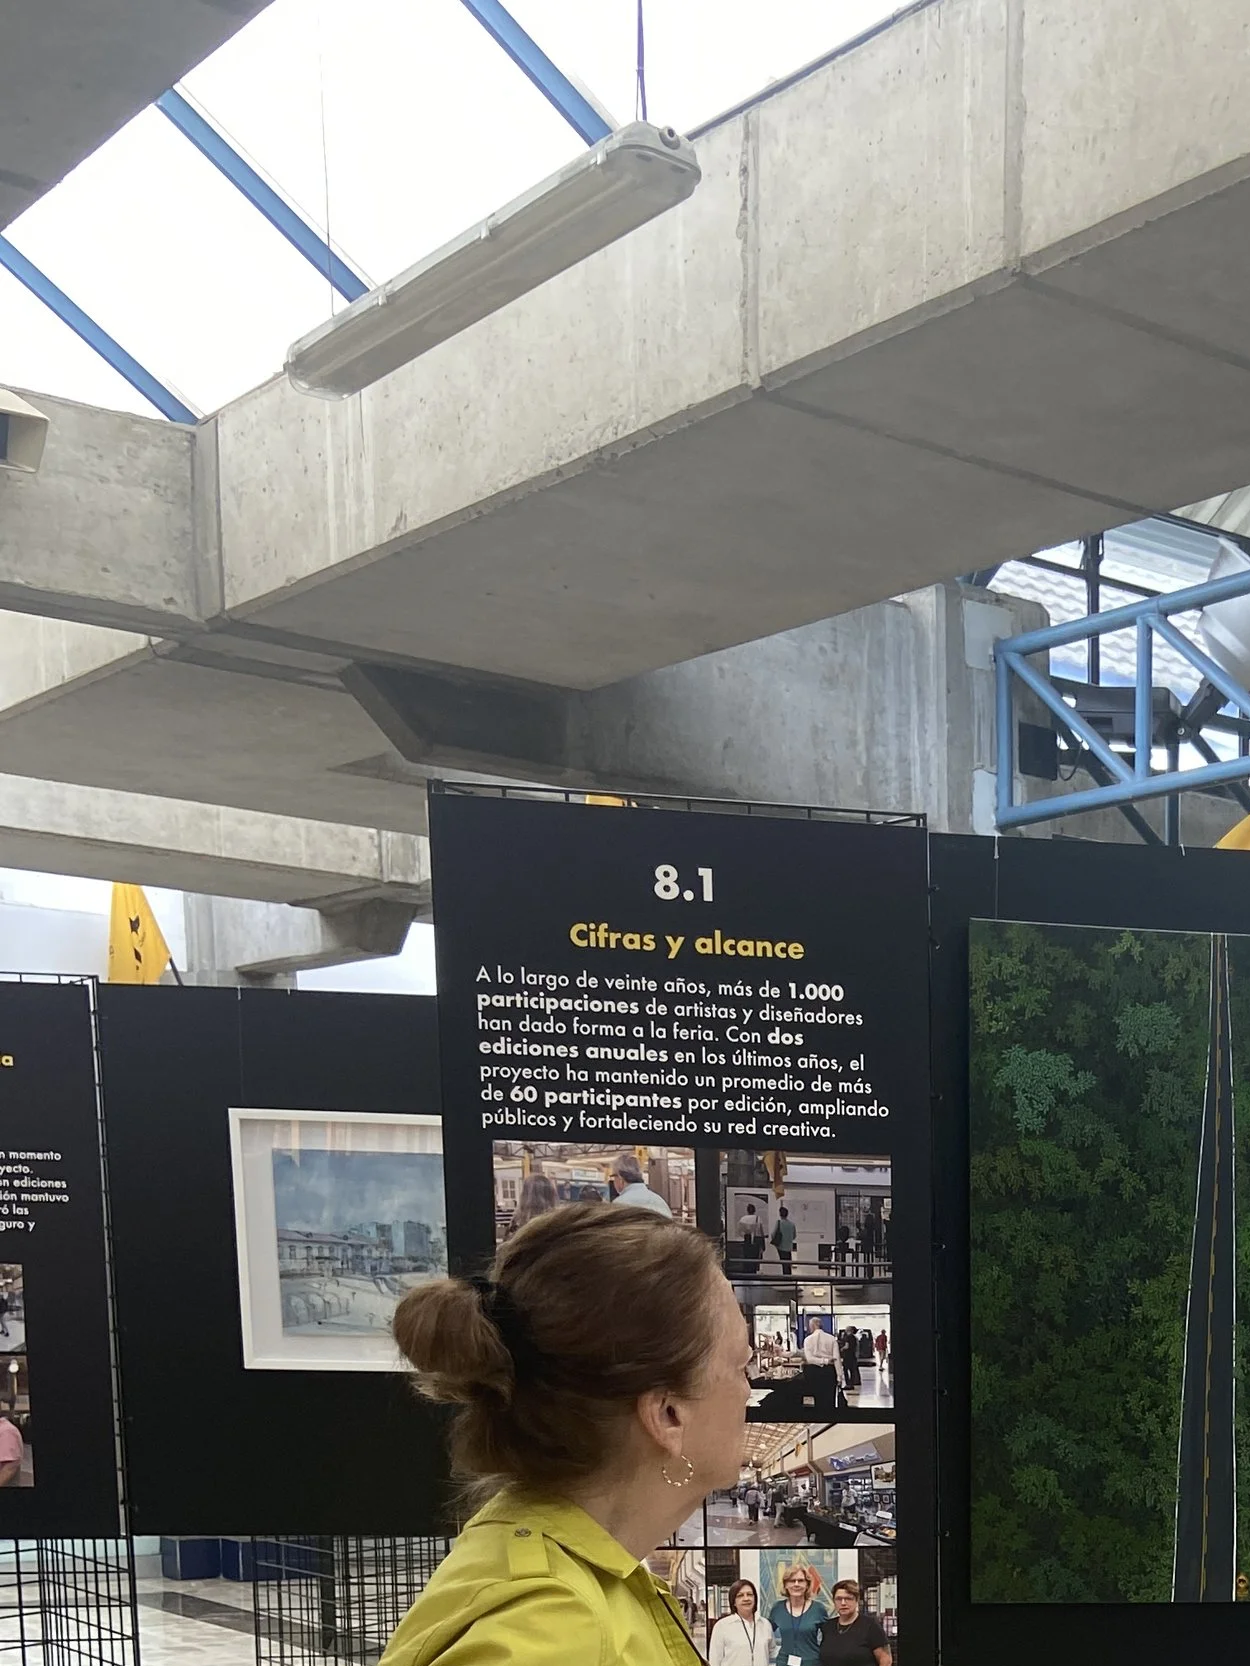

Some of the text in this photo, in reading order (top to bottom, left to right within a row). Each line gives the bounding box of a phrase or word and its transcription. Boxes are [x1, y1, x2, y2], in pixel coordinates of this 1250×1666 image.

[654, 864, 713, 902] 8.1
[570, 923, 804, 959] Cifras y alcance
[476, 965, 844, 1001] A lo largo de veinte años, más de 1.000
[477, 991, 863, 1025] participaciones de artistas y diseñadores
[478, 1012, 803, 1045] han dado forma a la feria. Con dos
[479, 1036, 864, 1073] ediciones anuales en los últimos años, el
[480, 1063, 872, 1094] proyecto ha mantenido un promedio de más
[481, 1083, 889, 1120] de 60 participantes por edición, ampliando
[482, 1107, 835, 1137] públicos y fortaleciendo su red creativa.
[9, 1151, 62, 1160] momento
[13, 1176, 67, 1188] ediciones
[20, 1192, 70, 1203] mantuvo
[12, 1203, 30, 1215] las
[27, 1221, 36, 1232] y
